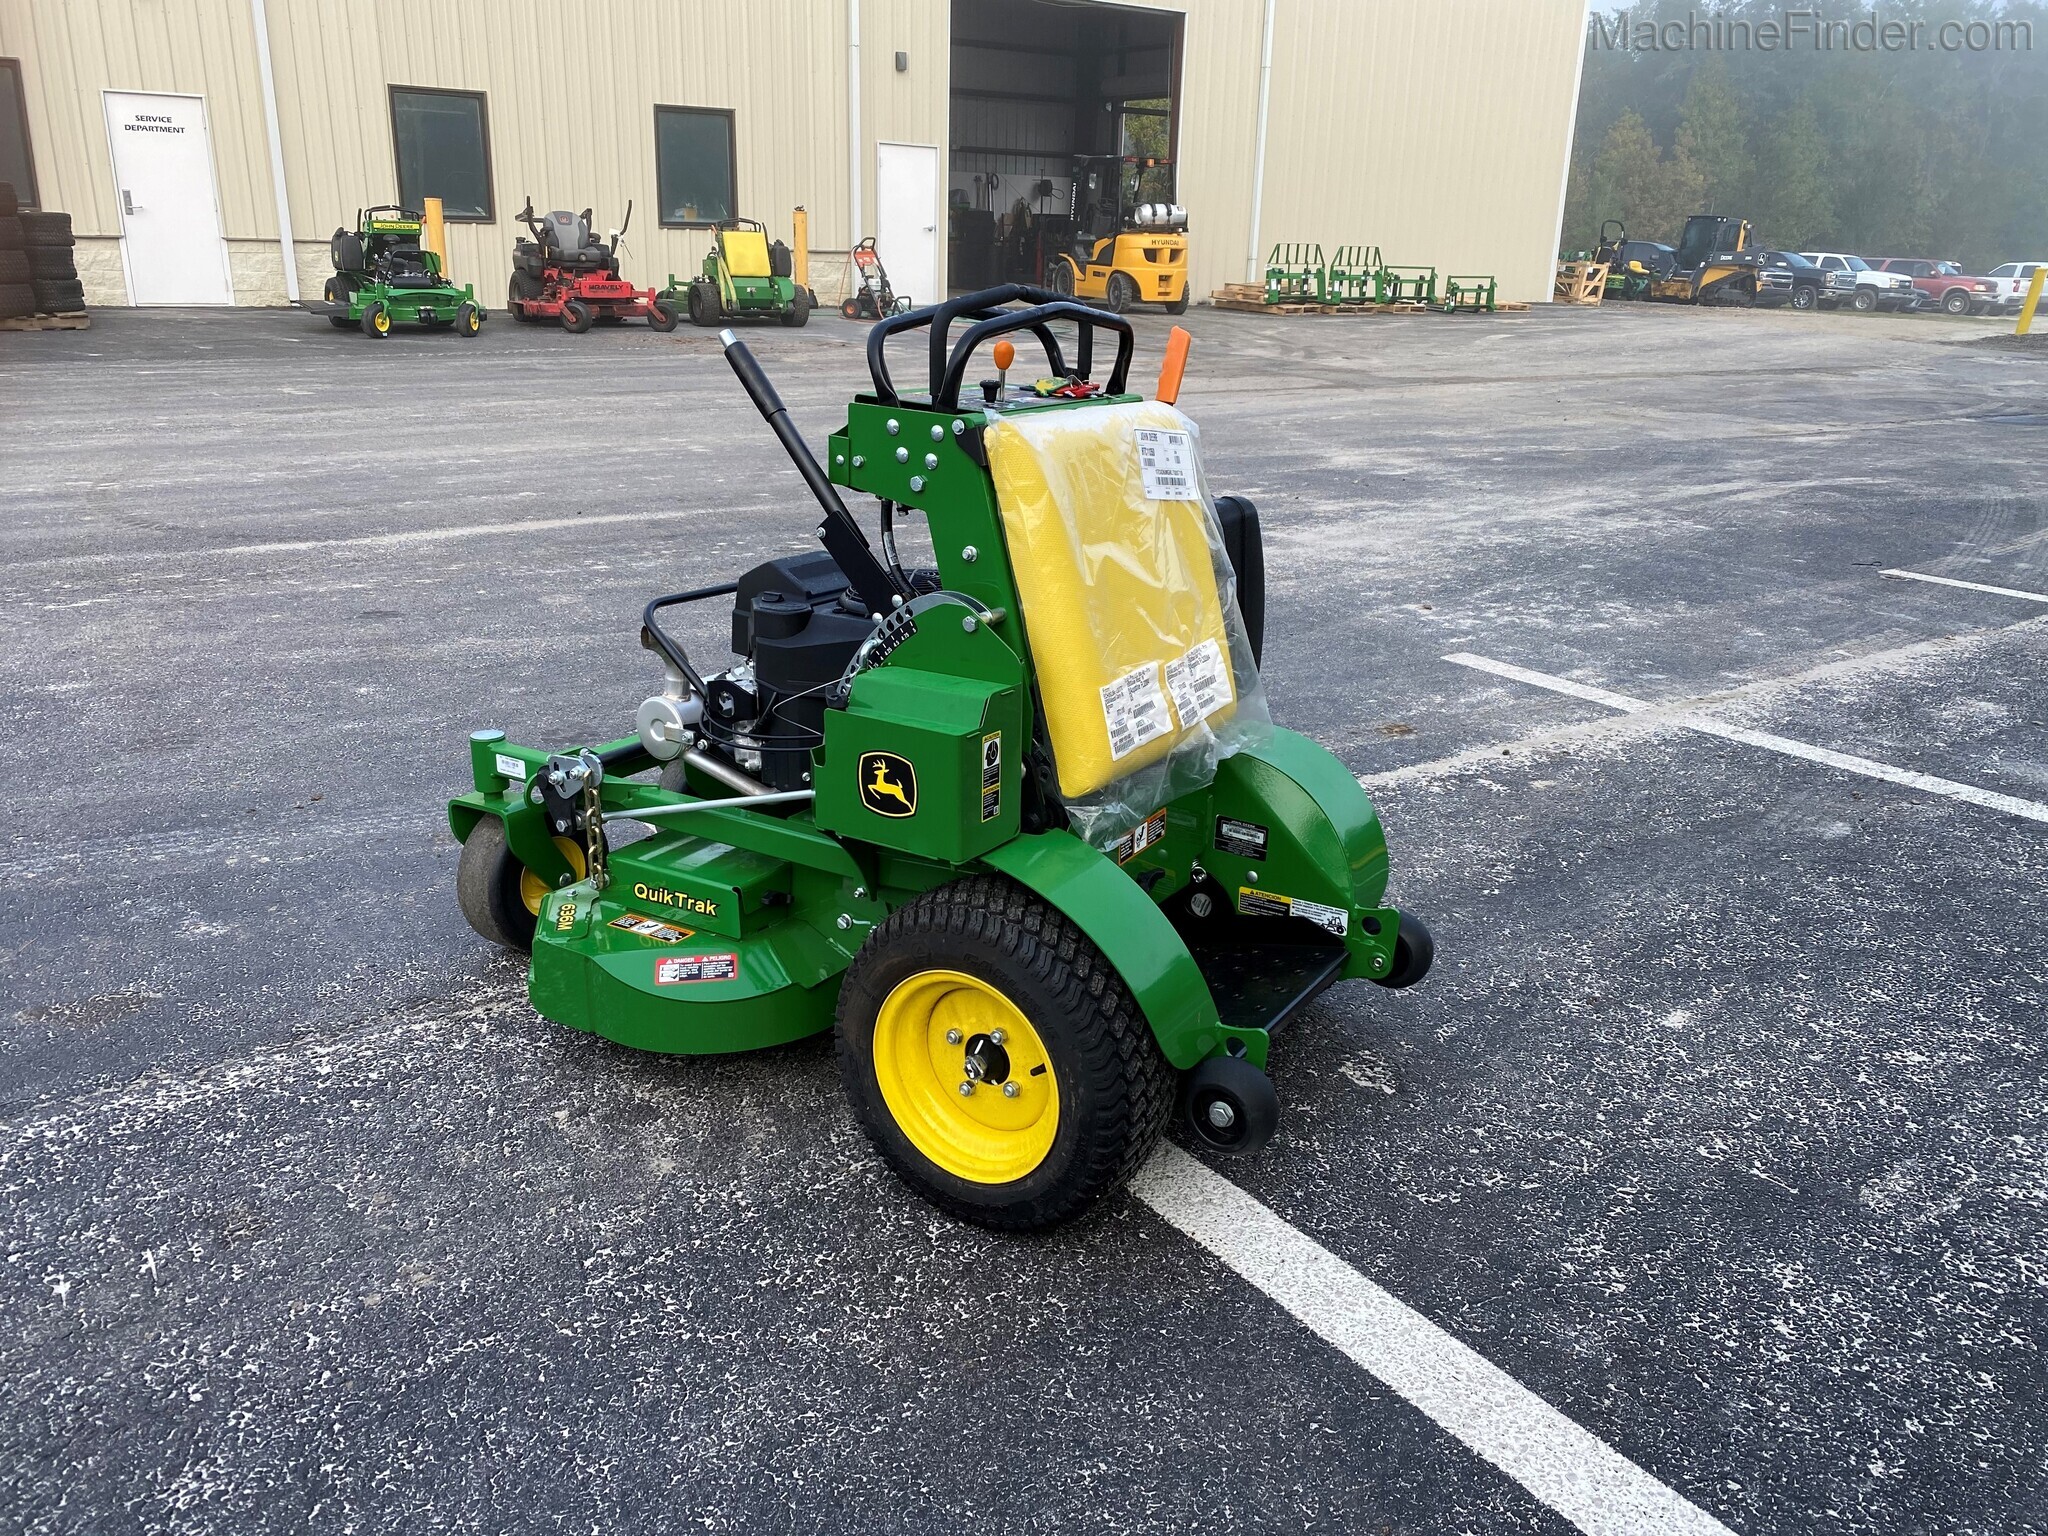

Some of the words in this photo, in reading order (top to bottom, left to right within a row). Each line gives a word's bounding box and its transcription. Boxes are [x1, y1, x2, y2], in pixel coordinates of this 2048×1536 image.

[135, 114, 173, 123] SERVICE
[124, 124, 186, 134] DEPARTMENT
[634, 883, 717, 916] QuikTrak
[557, 904, 576, 931] 636M
